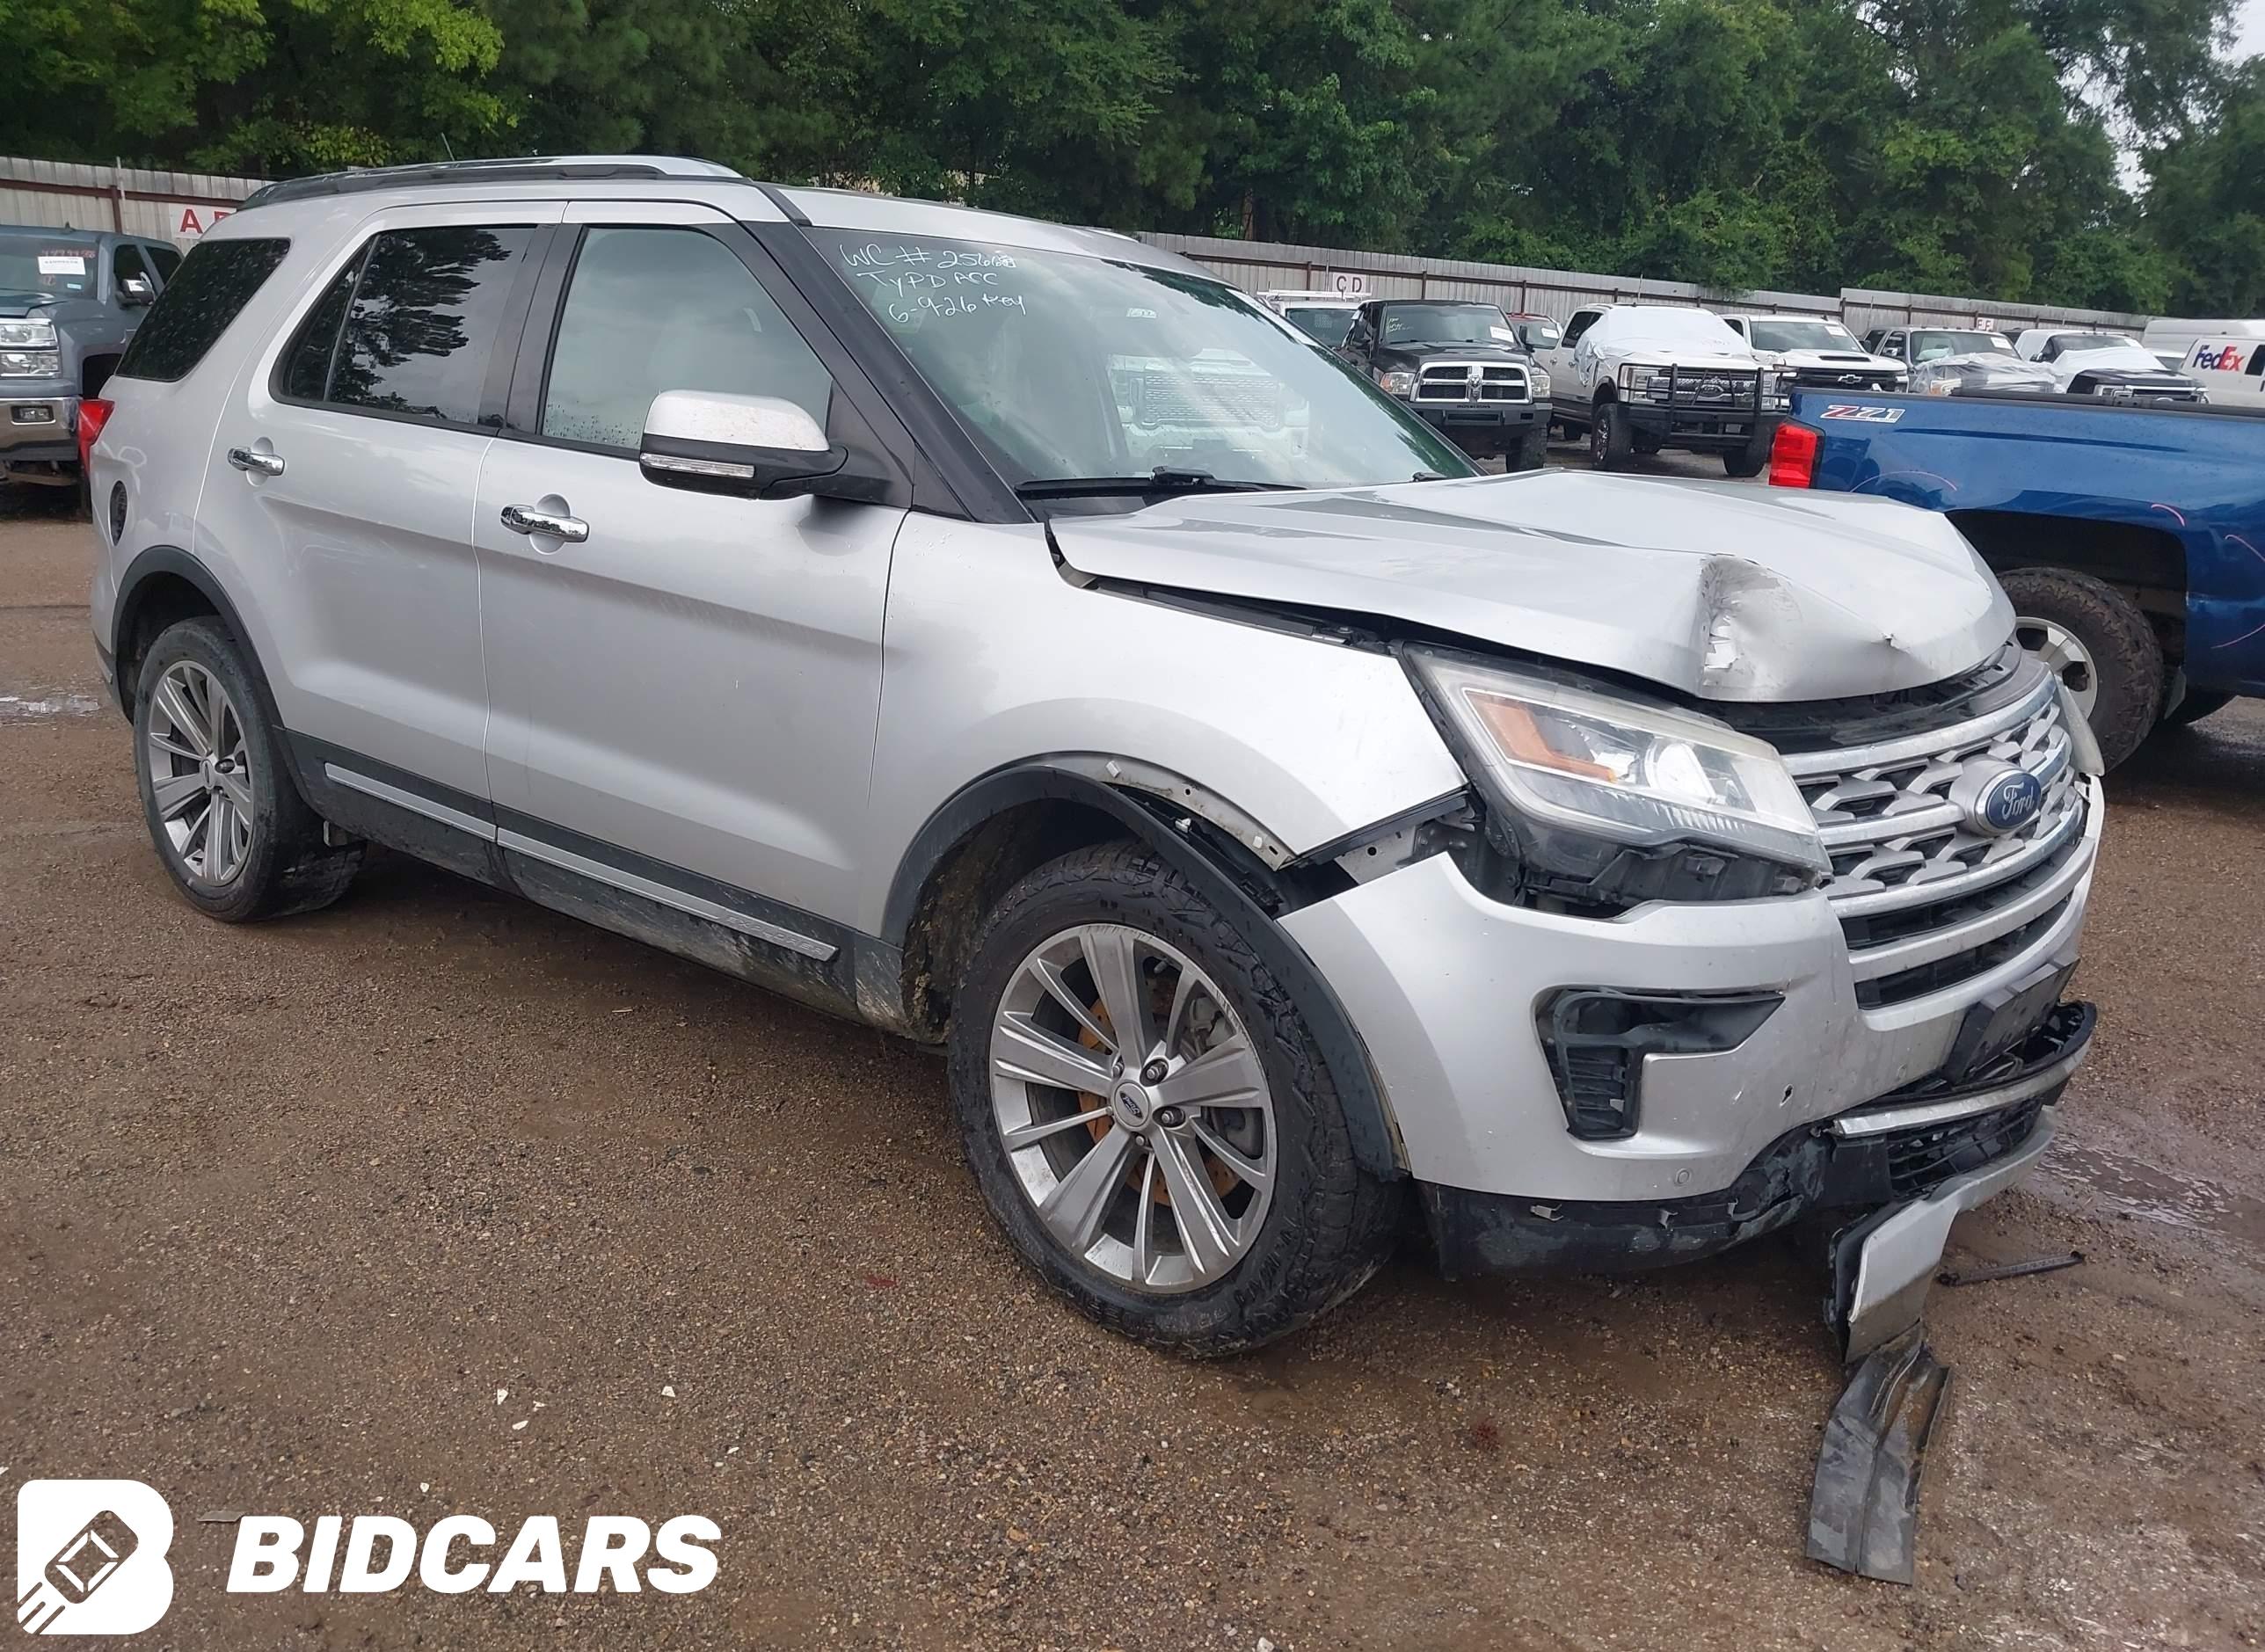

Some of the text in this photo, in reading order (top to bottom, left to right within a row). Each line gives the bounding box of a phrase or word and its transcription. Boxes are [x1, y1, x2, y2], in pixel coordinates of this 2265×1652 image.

[180, 209, 203, 234] A
[2192, 344, 2245, 371] FedEx
[1820, 404, 1905, 423] Z71
[2001, 781, 2035, 821] Ford
